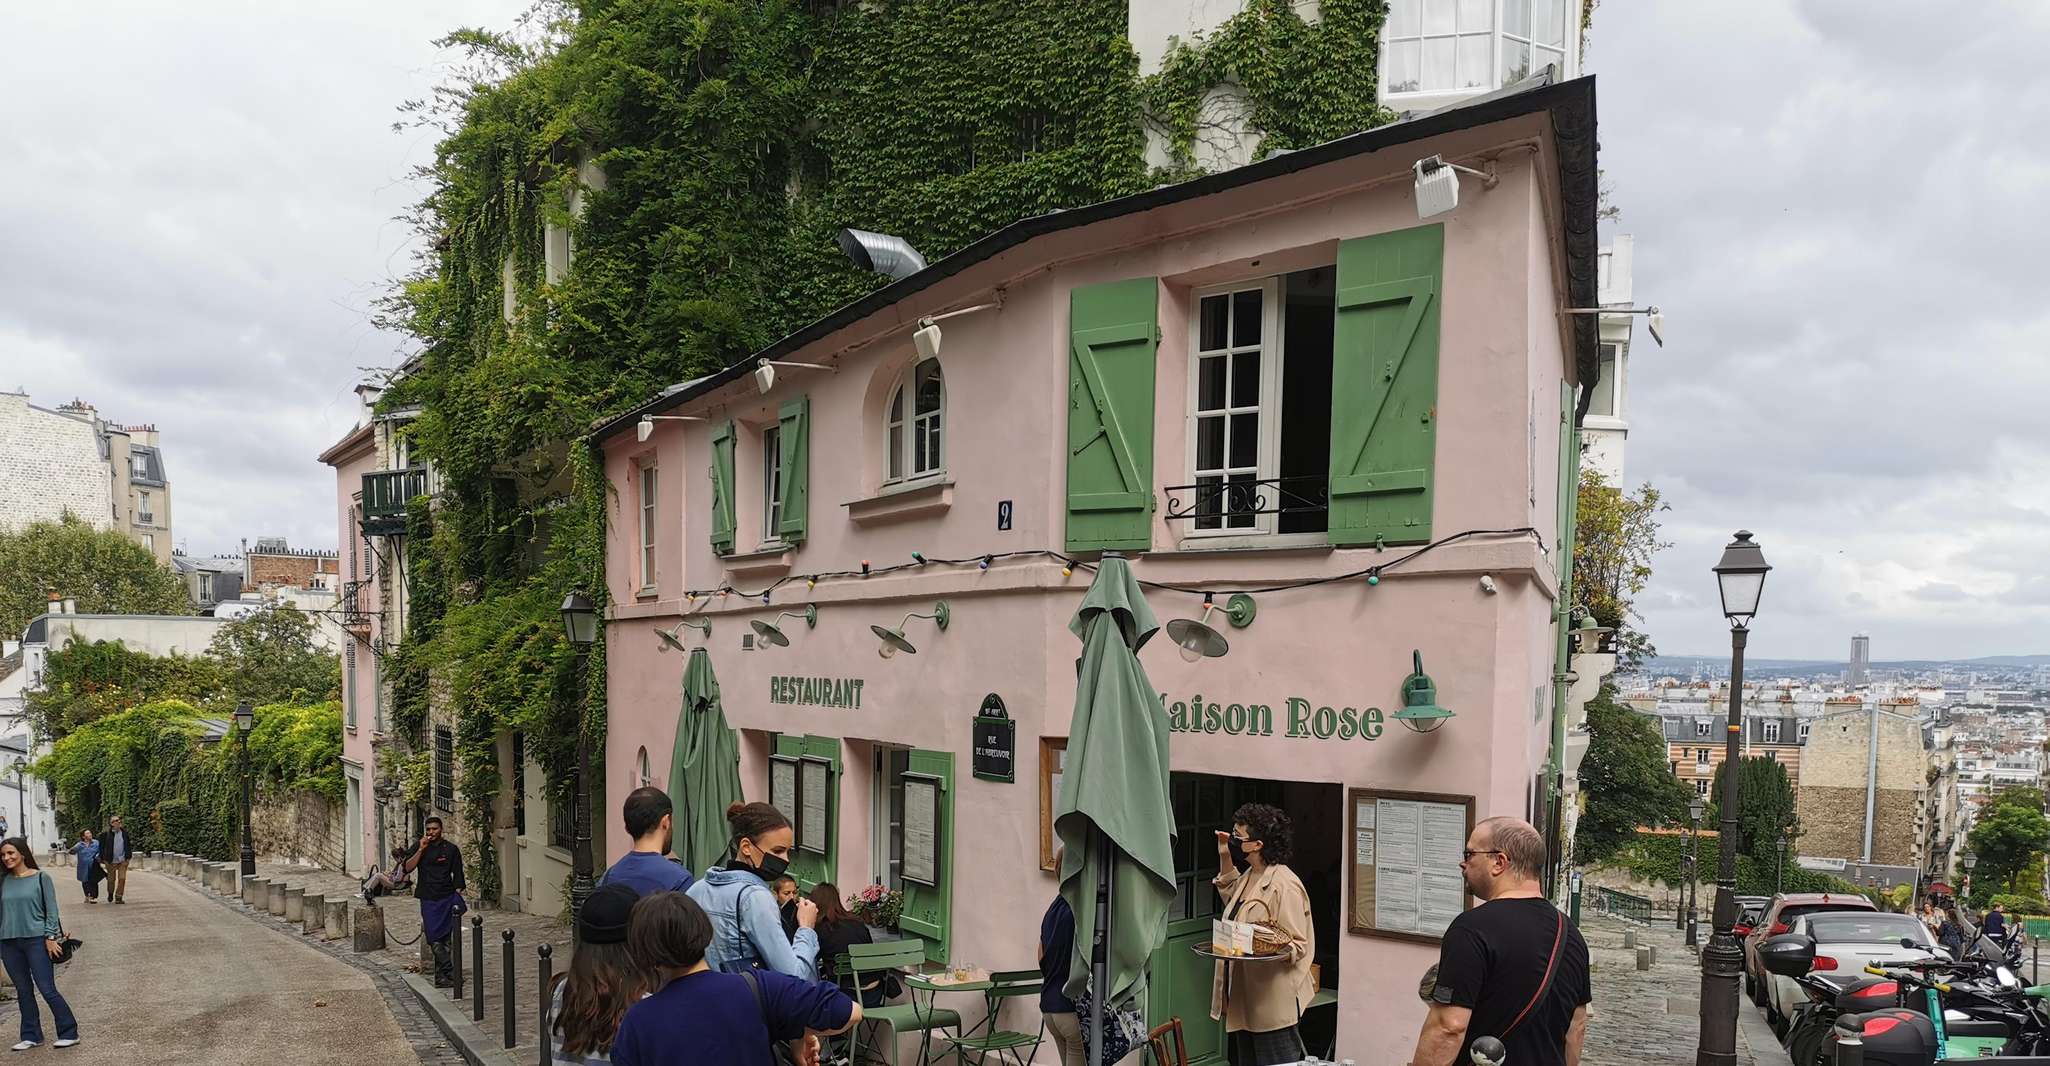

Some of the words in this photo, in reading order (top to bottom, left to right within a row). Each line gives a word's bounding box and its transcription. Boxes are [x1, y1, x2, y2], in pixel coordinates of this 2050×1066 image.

[1000, 503, 1009, 529] 2
[770, 676, 864, 709] RESTAURANT
[1160, 693, 1273, 736] aison
[1285, 697, 1384, 741] Rose
